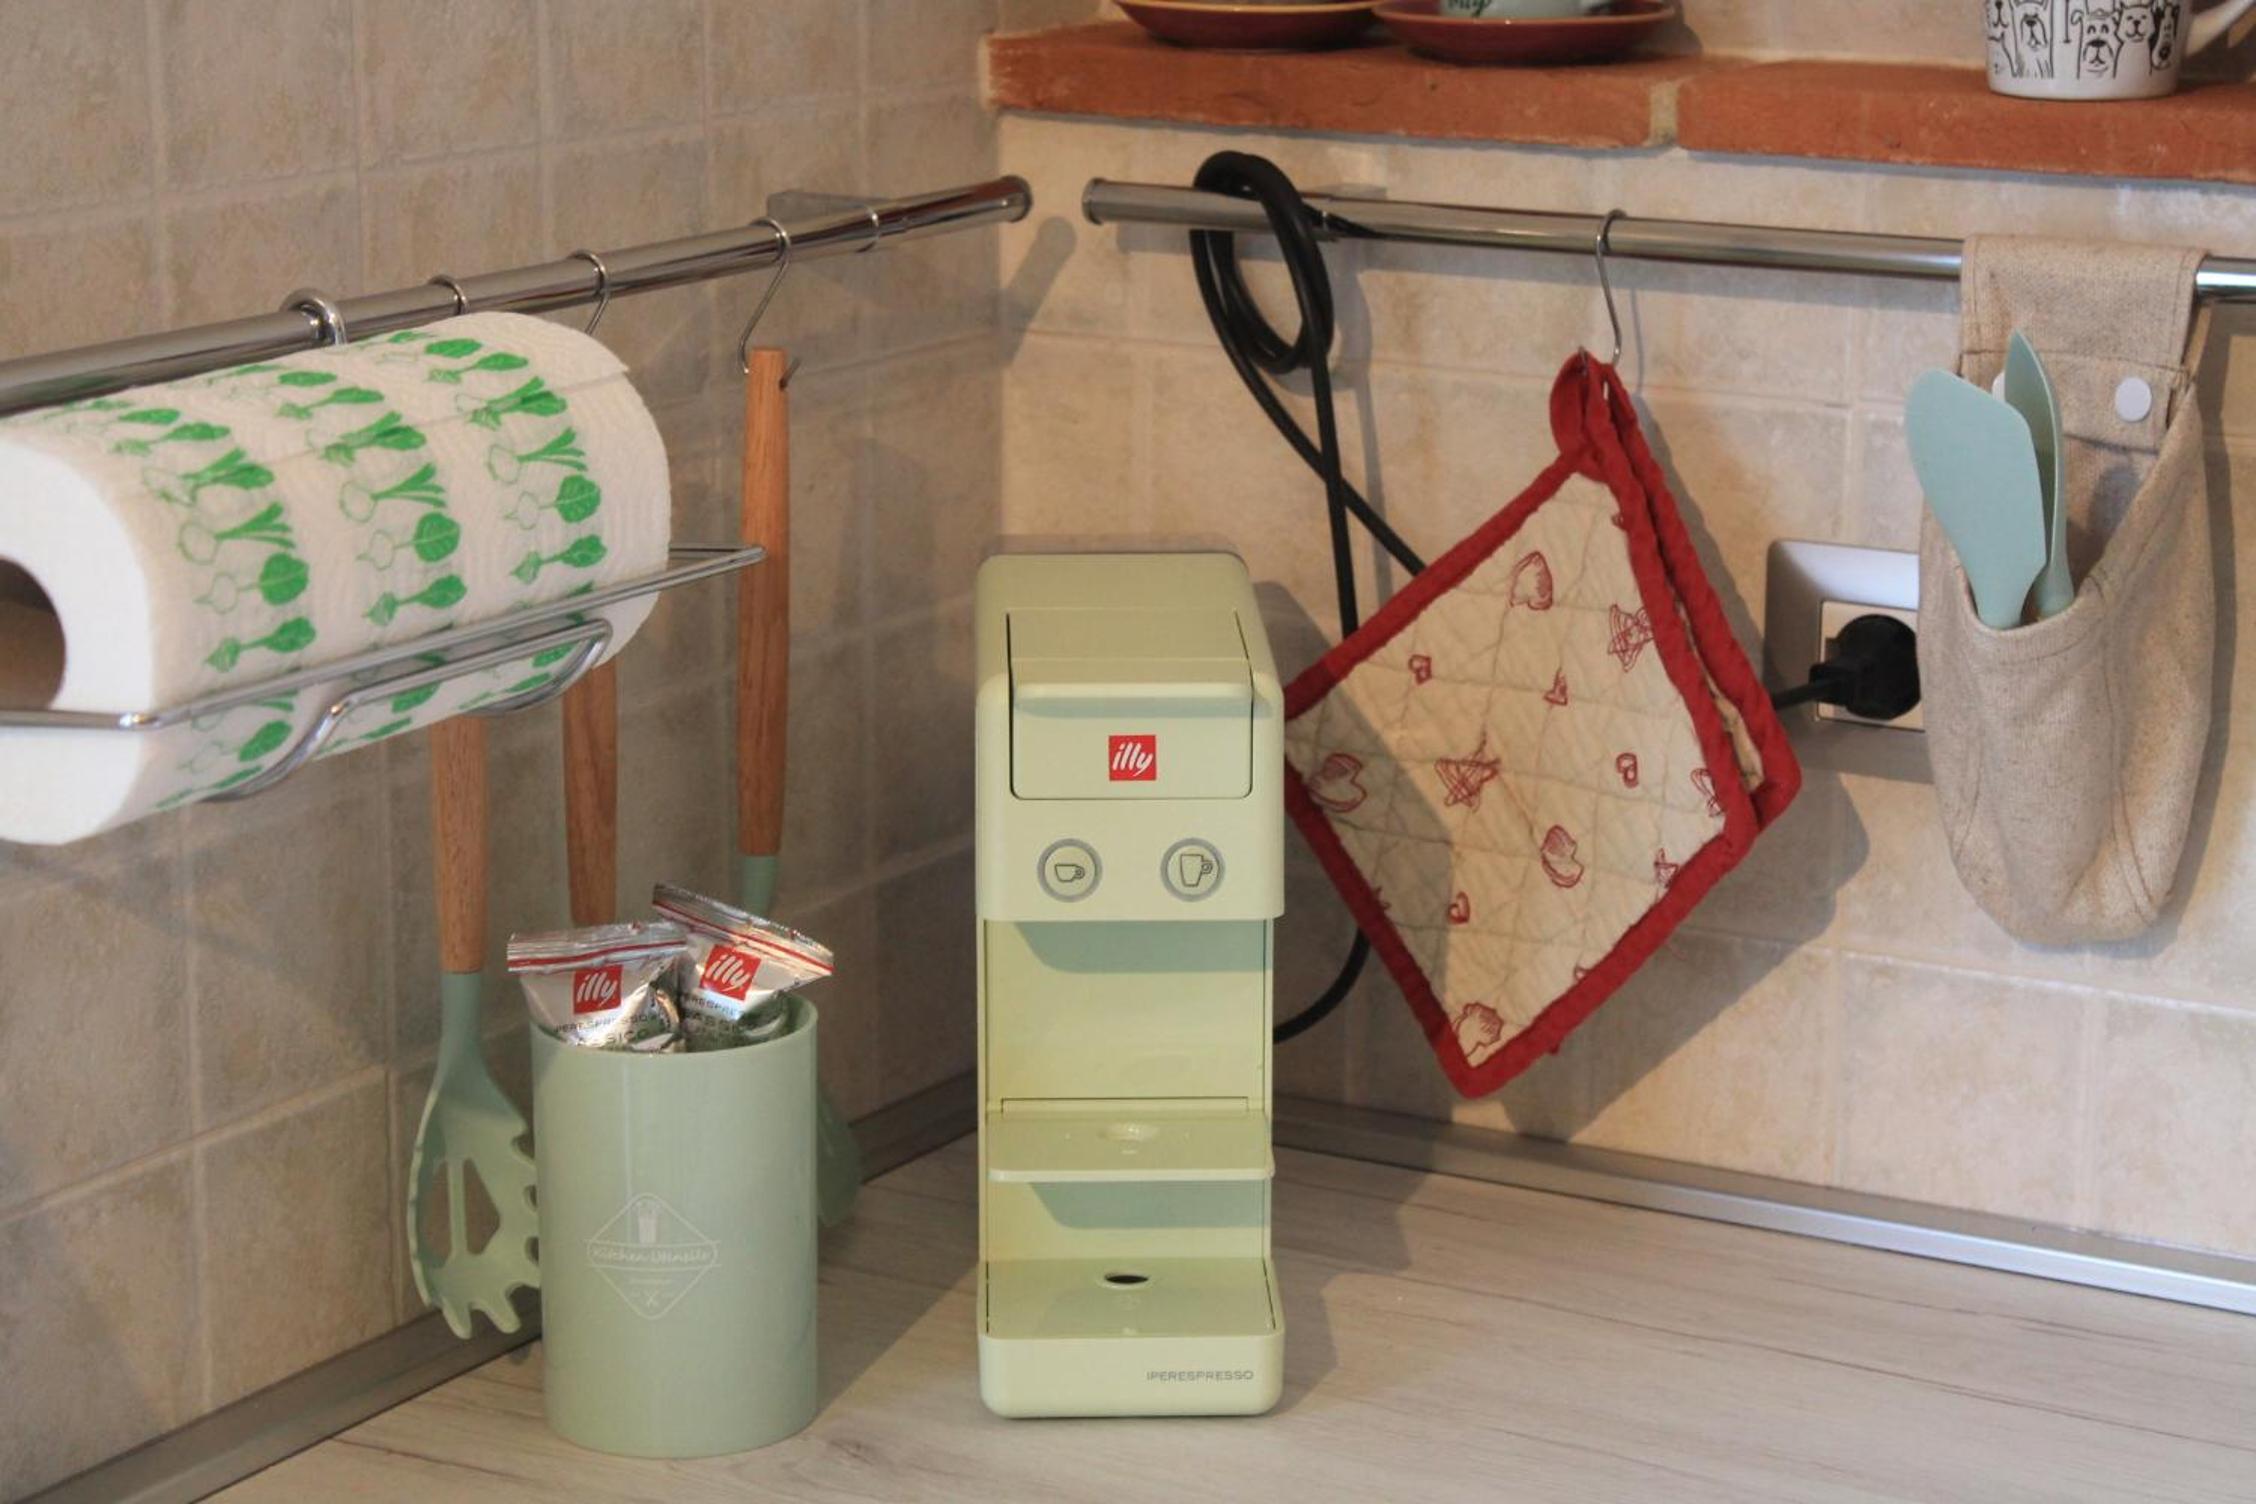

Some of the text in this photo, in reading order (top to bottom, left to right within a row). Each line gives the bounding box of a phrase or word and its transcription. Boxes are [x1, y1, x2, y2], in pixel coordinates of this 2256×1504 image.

[1112, 742, 1153, 777] illy
[576, 971, 618, 1006] illy
[706, 953, 752, 992] illy
[1146, 1369, 1255, 1382] IPERESPRESSO
